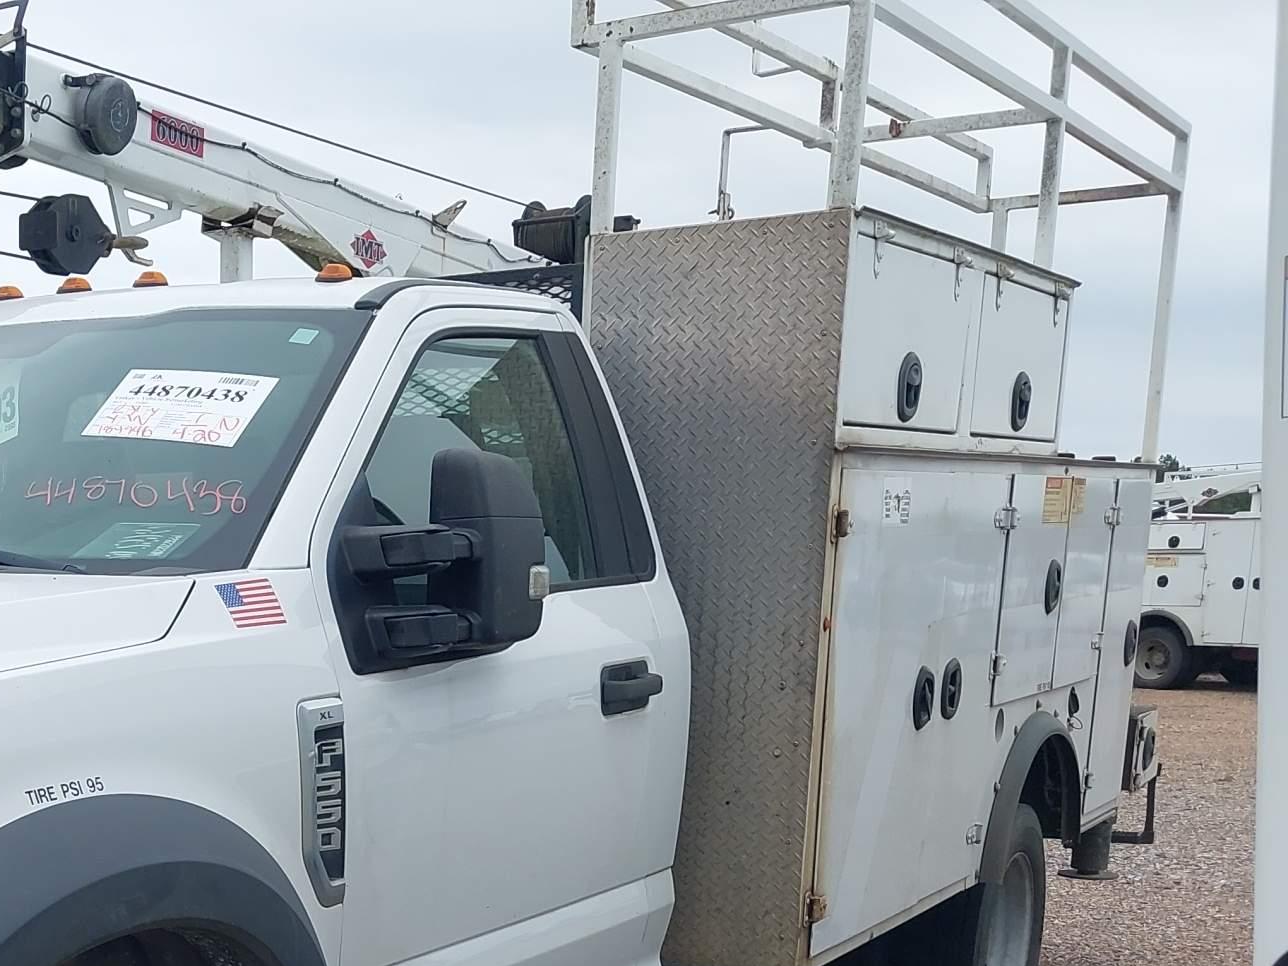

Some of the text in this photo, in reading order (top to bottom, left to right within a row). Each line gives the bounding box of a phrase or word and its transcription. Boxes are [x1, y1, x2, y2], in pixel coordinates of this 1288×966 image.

[156, 116, 200, 153] 6000
[353, 233, 384, 264] IMT
[129, 384, 248, 403] 44870438
[24, 476, 248, 515] 44870438
[319, 711, 334, 721] XL
[24, 776, 104, 806] TIRE PSI 95
[315, 738, 343, 852] F550
